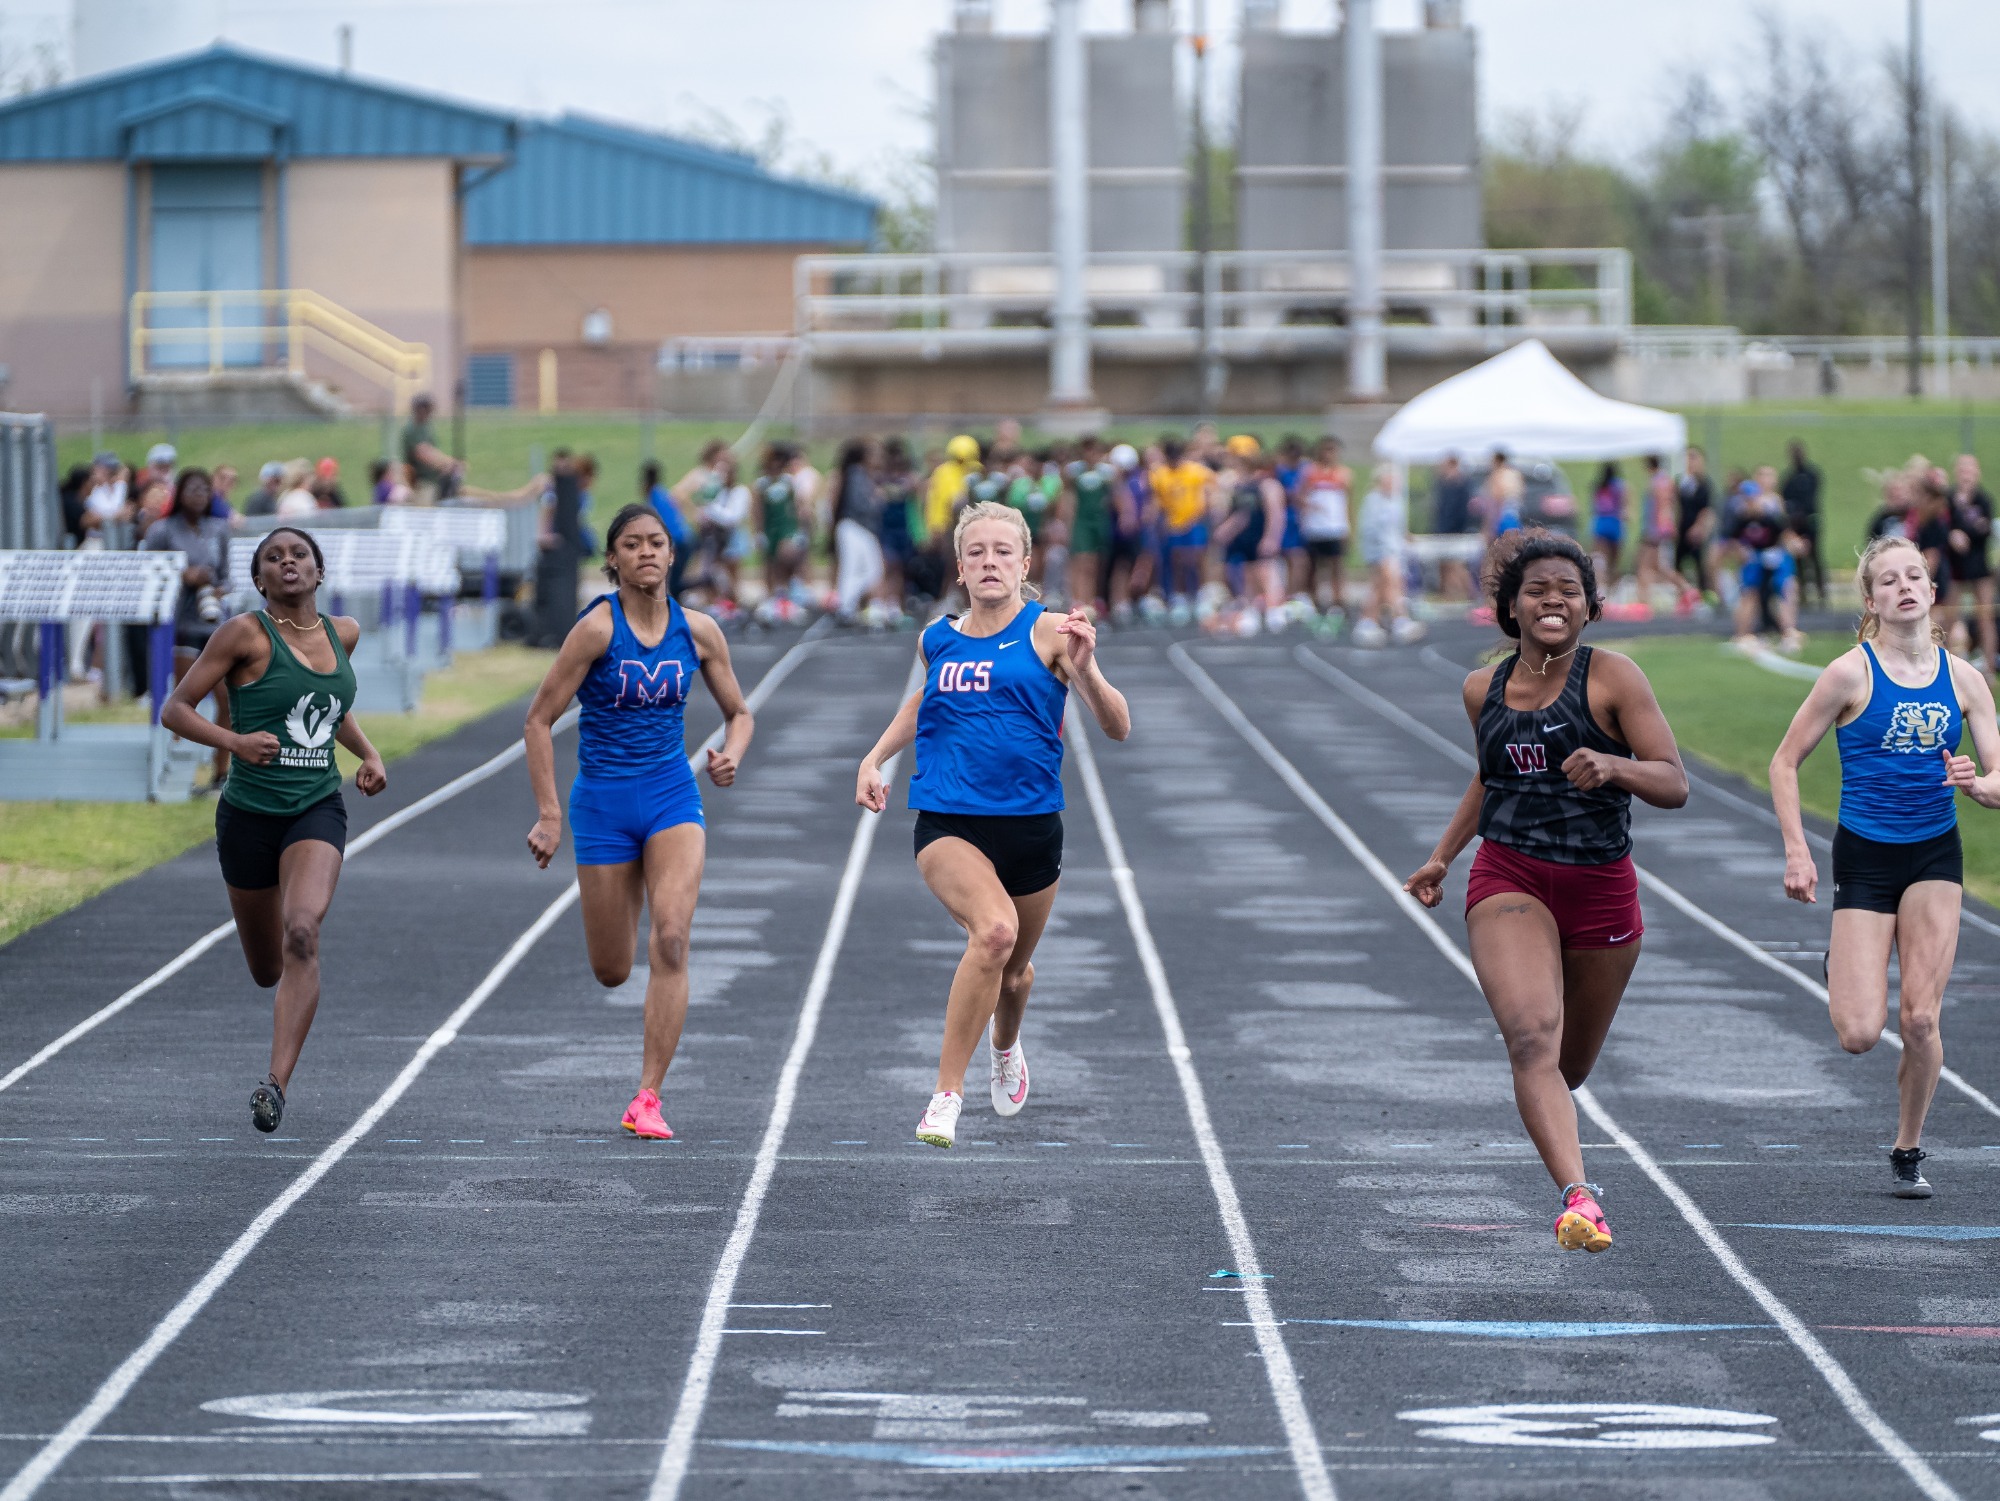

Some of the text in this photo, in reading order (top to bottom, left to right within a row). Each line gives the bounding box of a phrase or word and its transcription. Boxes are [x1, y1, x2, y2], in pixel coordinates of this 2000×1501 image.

[614, 659, 684, 708] M
[938, 661, 994, 692] OCS
[280, 747, 329, 758] HARDING
[1505, 743, 1548, 774] W
